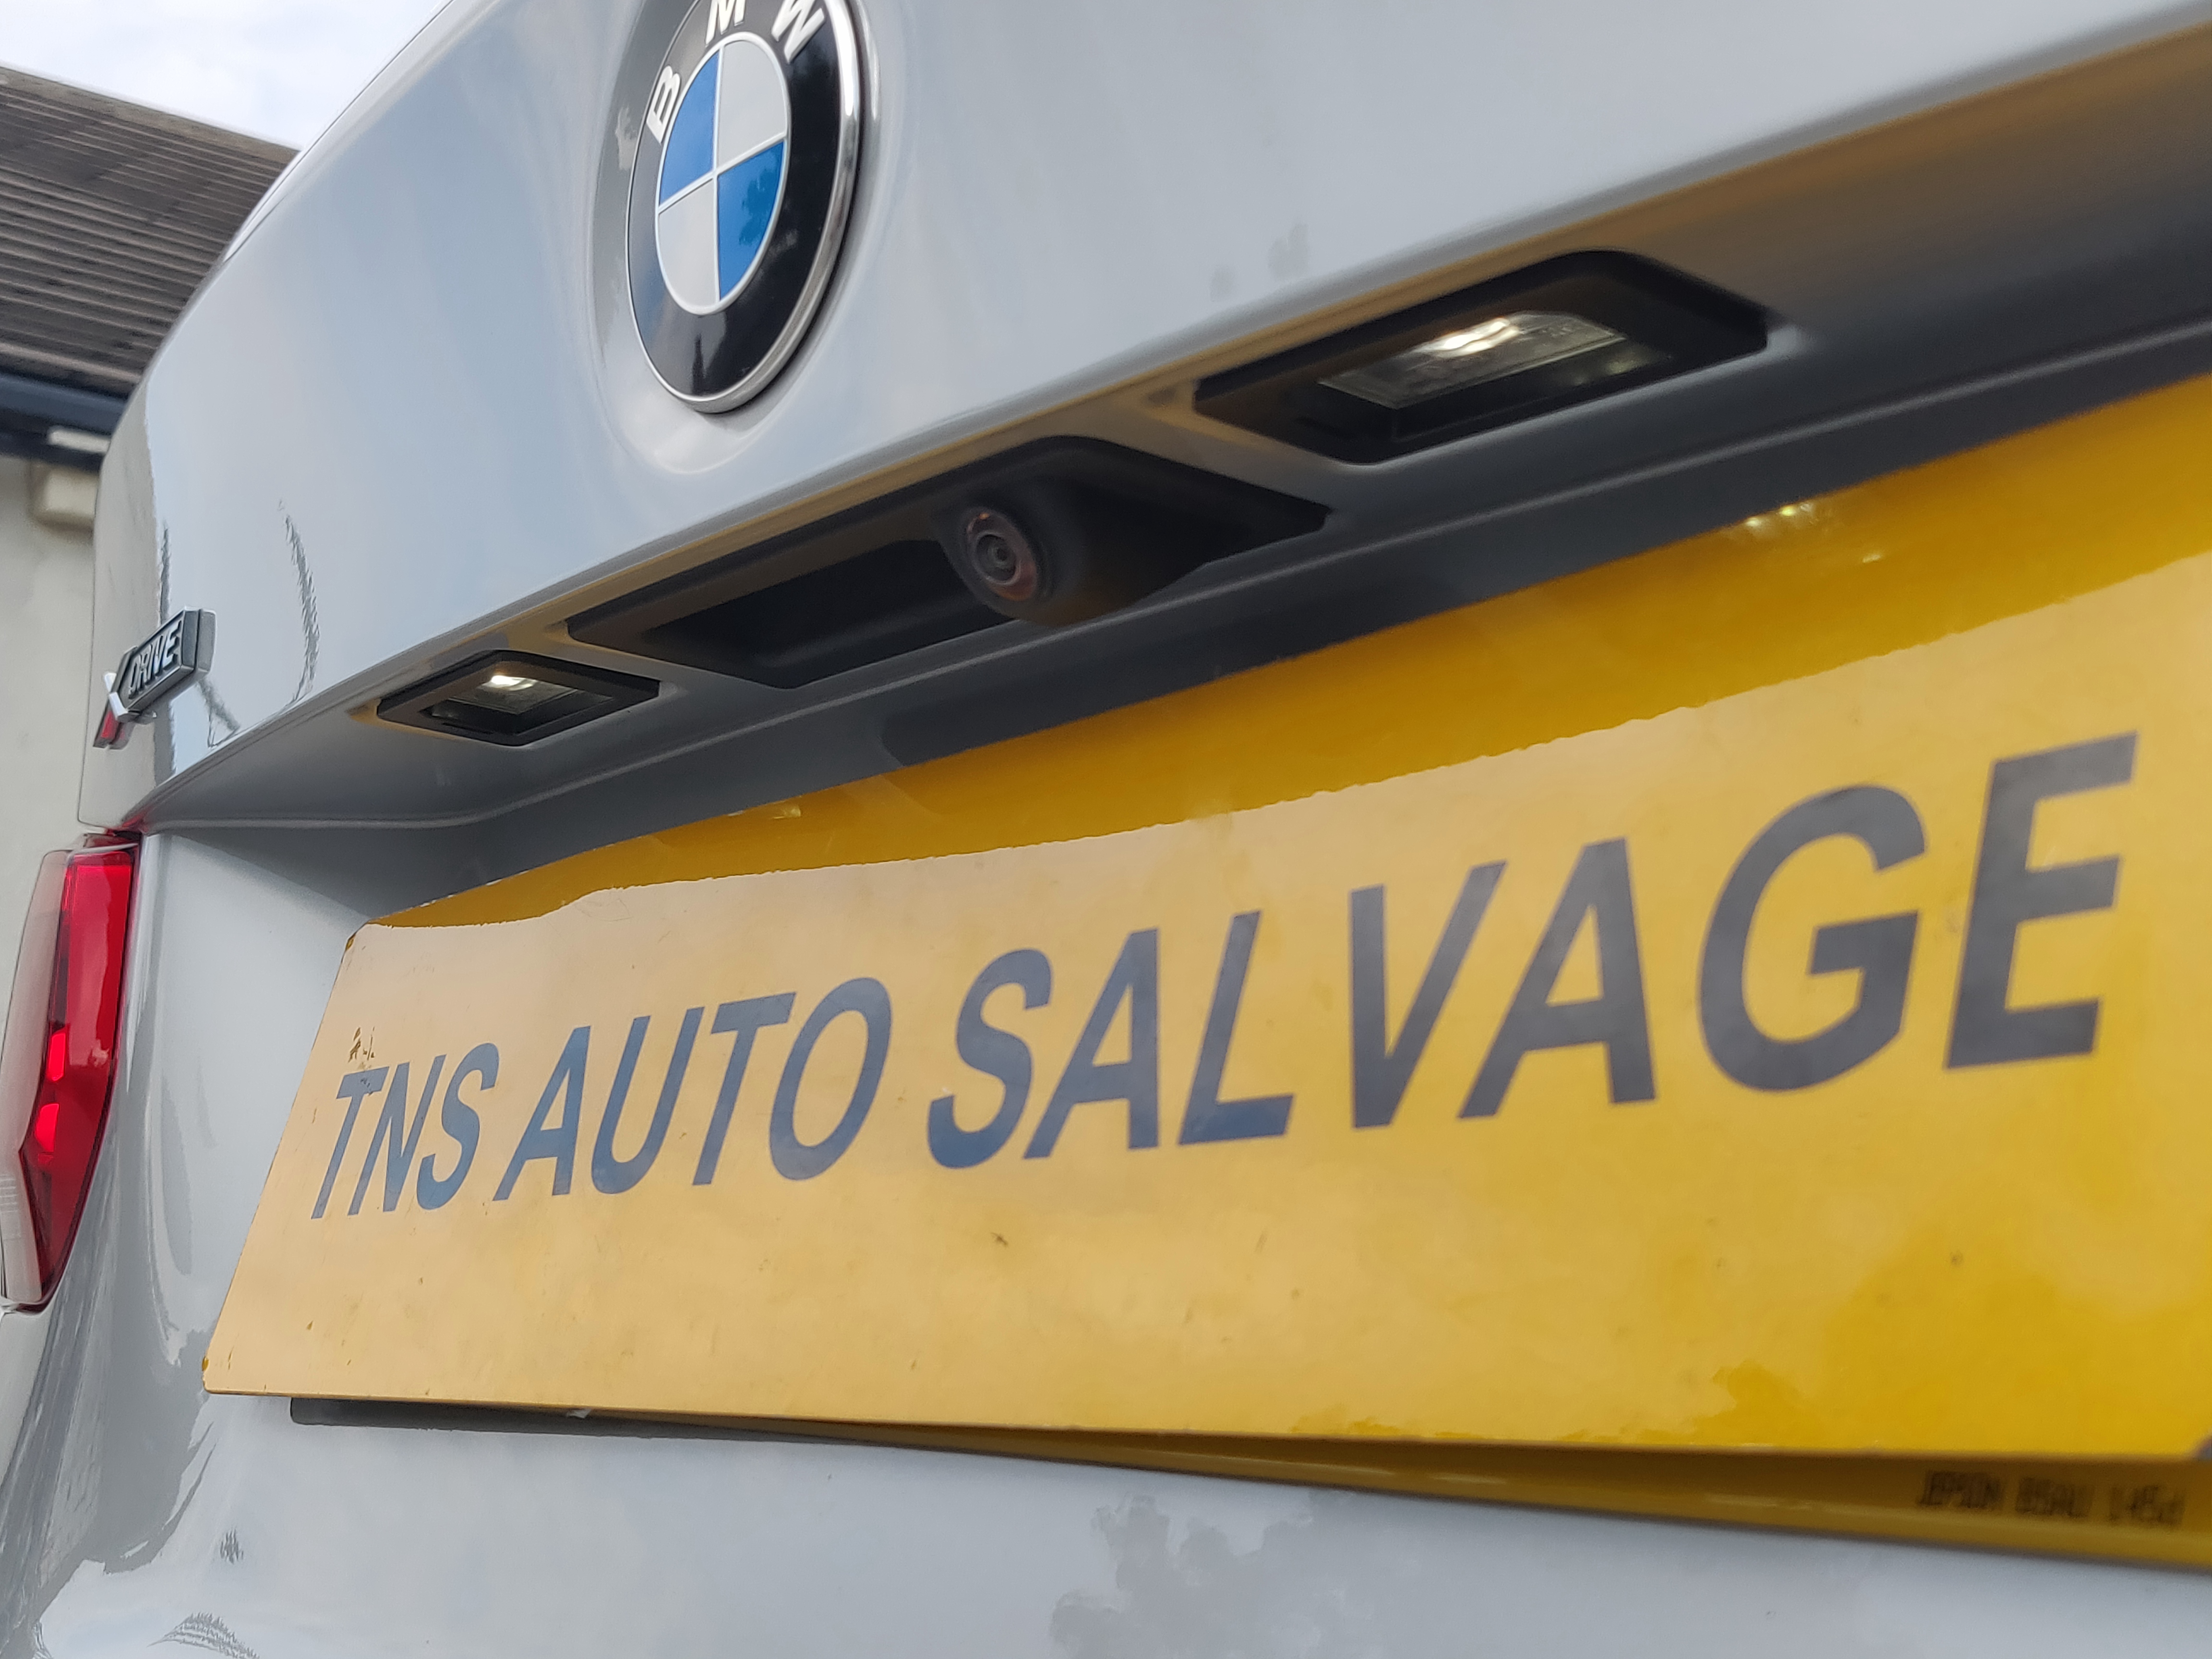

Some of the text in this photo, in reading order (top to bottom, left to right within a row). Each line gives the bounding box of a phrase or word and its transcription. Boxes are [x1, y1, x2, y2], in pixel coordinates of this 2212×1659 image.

[646, 0, 825, 145] BMW
[311, 732, 2139, 1219] TNS AUTO SALVAGE
